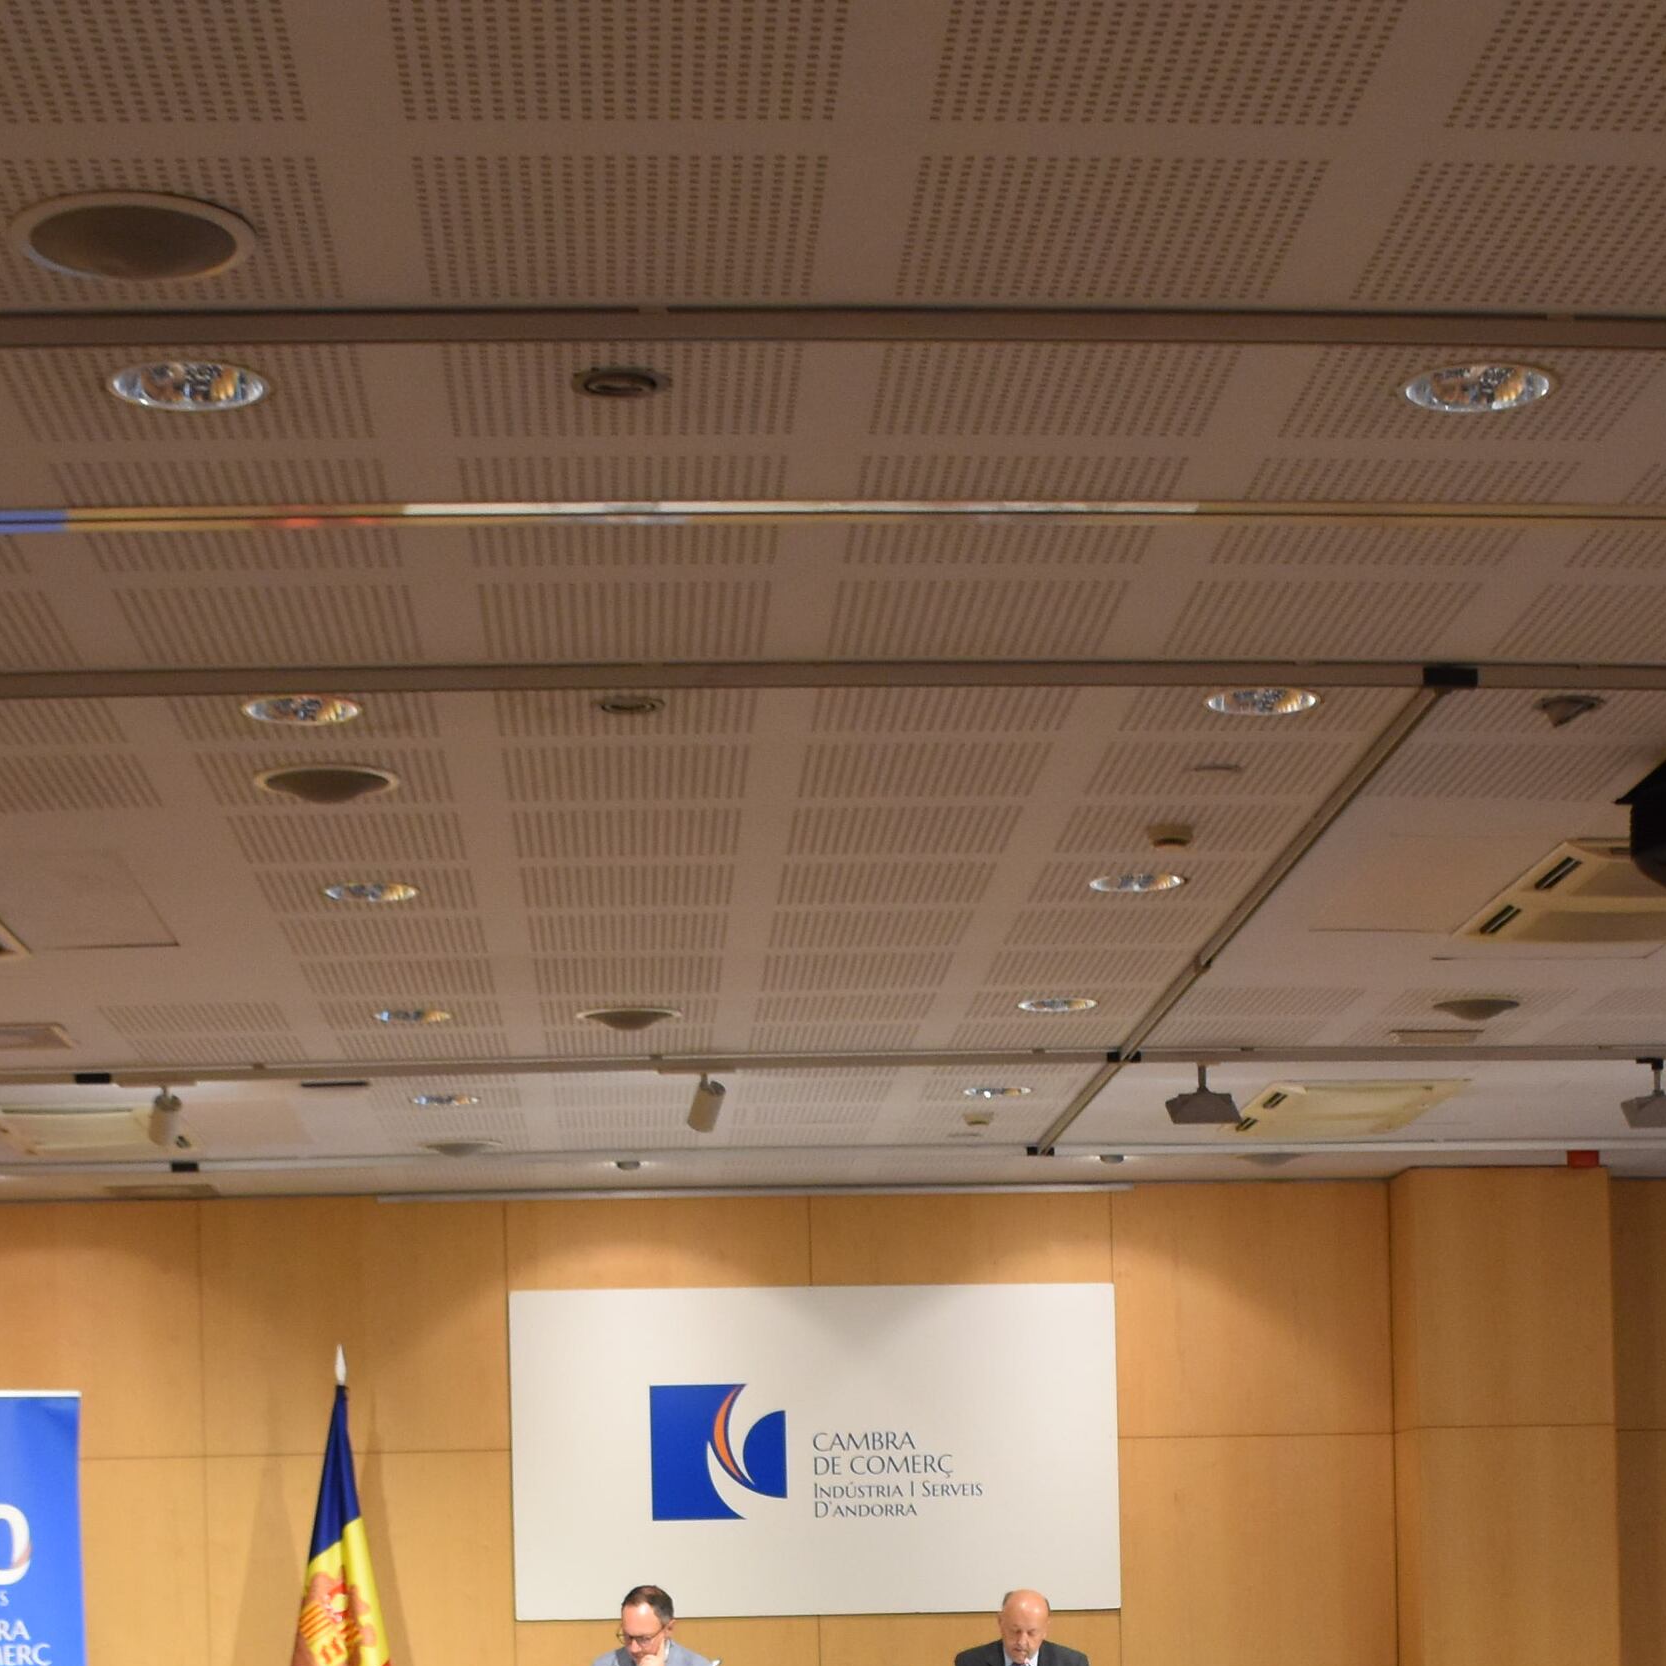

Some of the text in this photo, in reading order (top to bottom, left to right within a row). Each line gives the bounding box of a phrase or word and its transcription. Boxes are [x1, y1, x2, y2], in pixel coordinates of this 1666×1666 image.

[813, 1432, 916, 1451] CAMBRA
[814, 1454, 954, 1478] DE COMERÇ
[910, 1481, 915, 1497] I
[922, 1480, 983, 1497] SERVEIS
